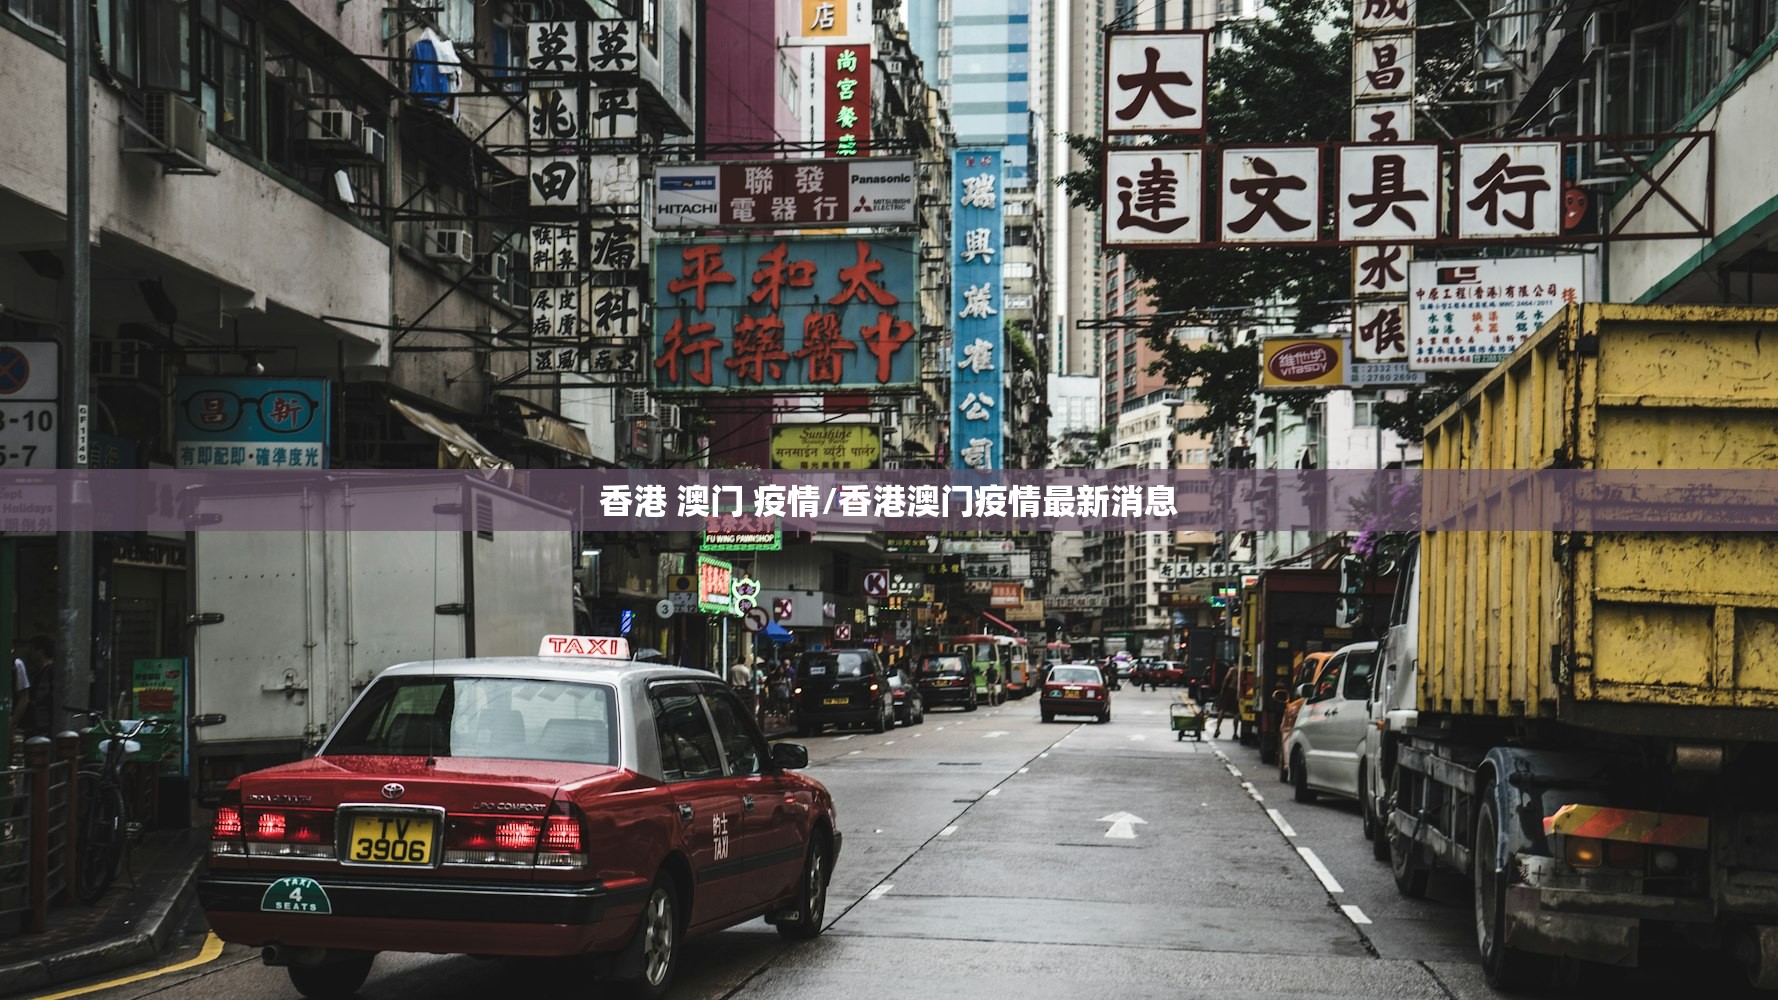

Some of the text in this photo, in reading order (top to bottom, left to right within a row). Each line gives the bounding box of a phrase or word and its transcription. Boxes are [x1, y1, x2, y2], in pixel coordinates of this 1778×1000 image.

[811, 2, 834, 30] 店
[745, 166, 824, 195] 聯發
[851, 174, 911, 184] Panasonic
[658, 203, 717, 214] HITACHI
[730, 196, 838, 222] 電器行
[668, 239, 899, 313] 太和平
[1416, 284, 1557, 301] 中原工程(香港)有限公司
[654, 311, 917, 386] 中醫藥行
[799, 427, 852, 440] Sunshine
[717, 535, 735, 543] WING
[736, 535, 775, 543] PAWNSHOP
[549, 638, 617, 655] TAXI
[497, 803, 546, 812] COMFORT
[379, 819, 410, 840] TV
[713, 812, 728, 835] 的士
[356, 838, 425, 862] 3906
[713, 836, 728, 860] TAXI
[283, 878, 312, 888] TAXI
[289, 887, 302, 902] 4
[275, 901, 317, 911] SEATS
